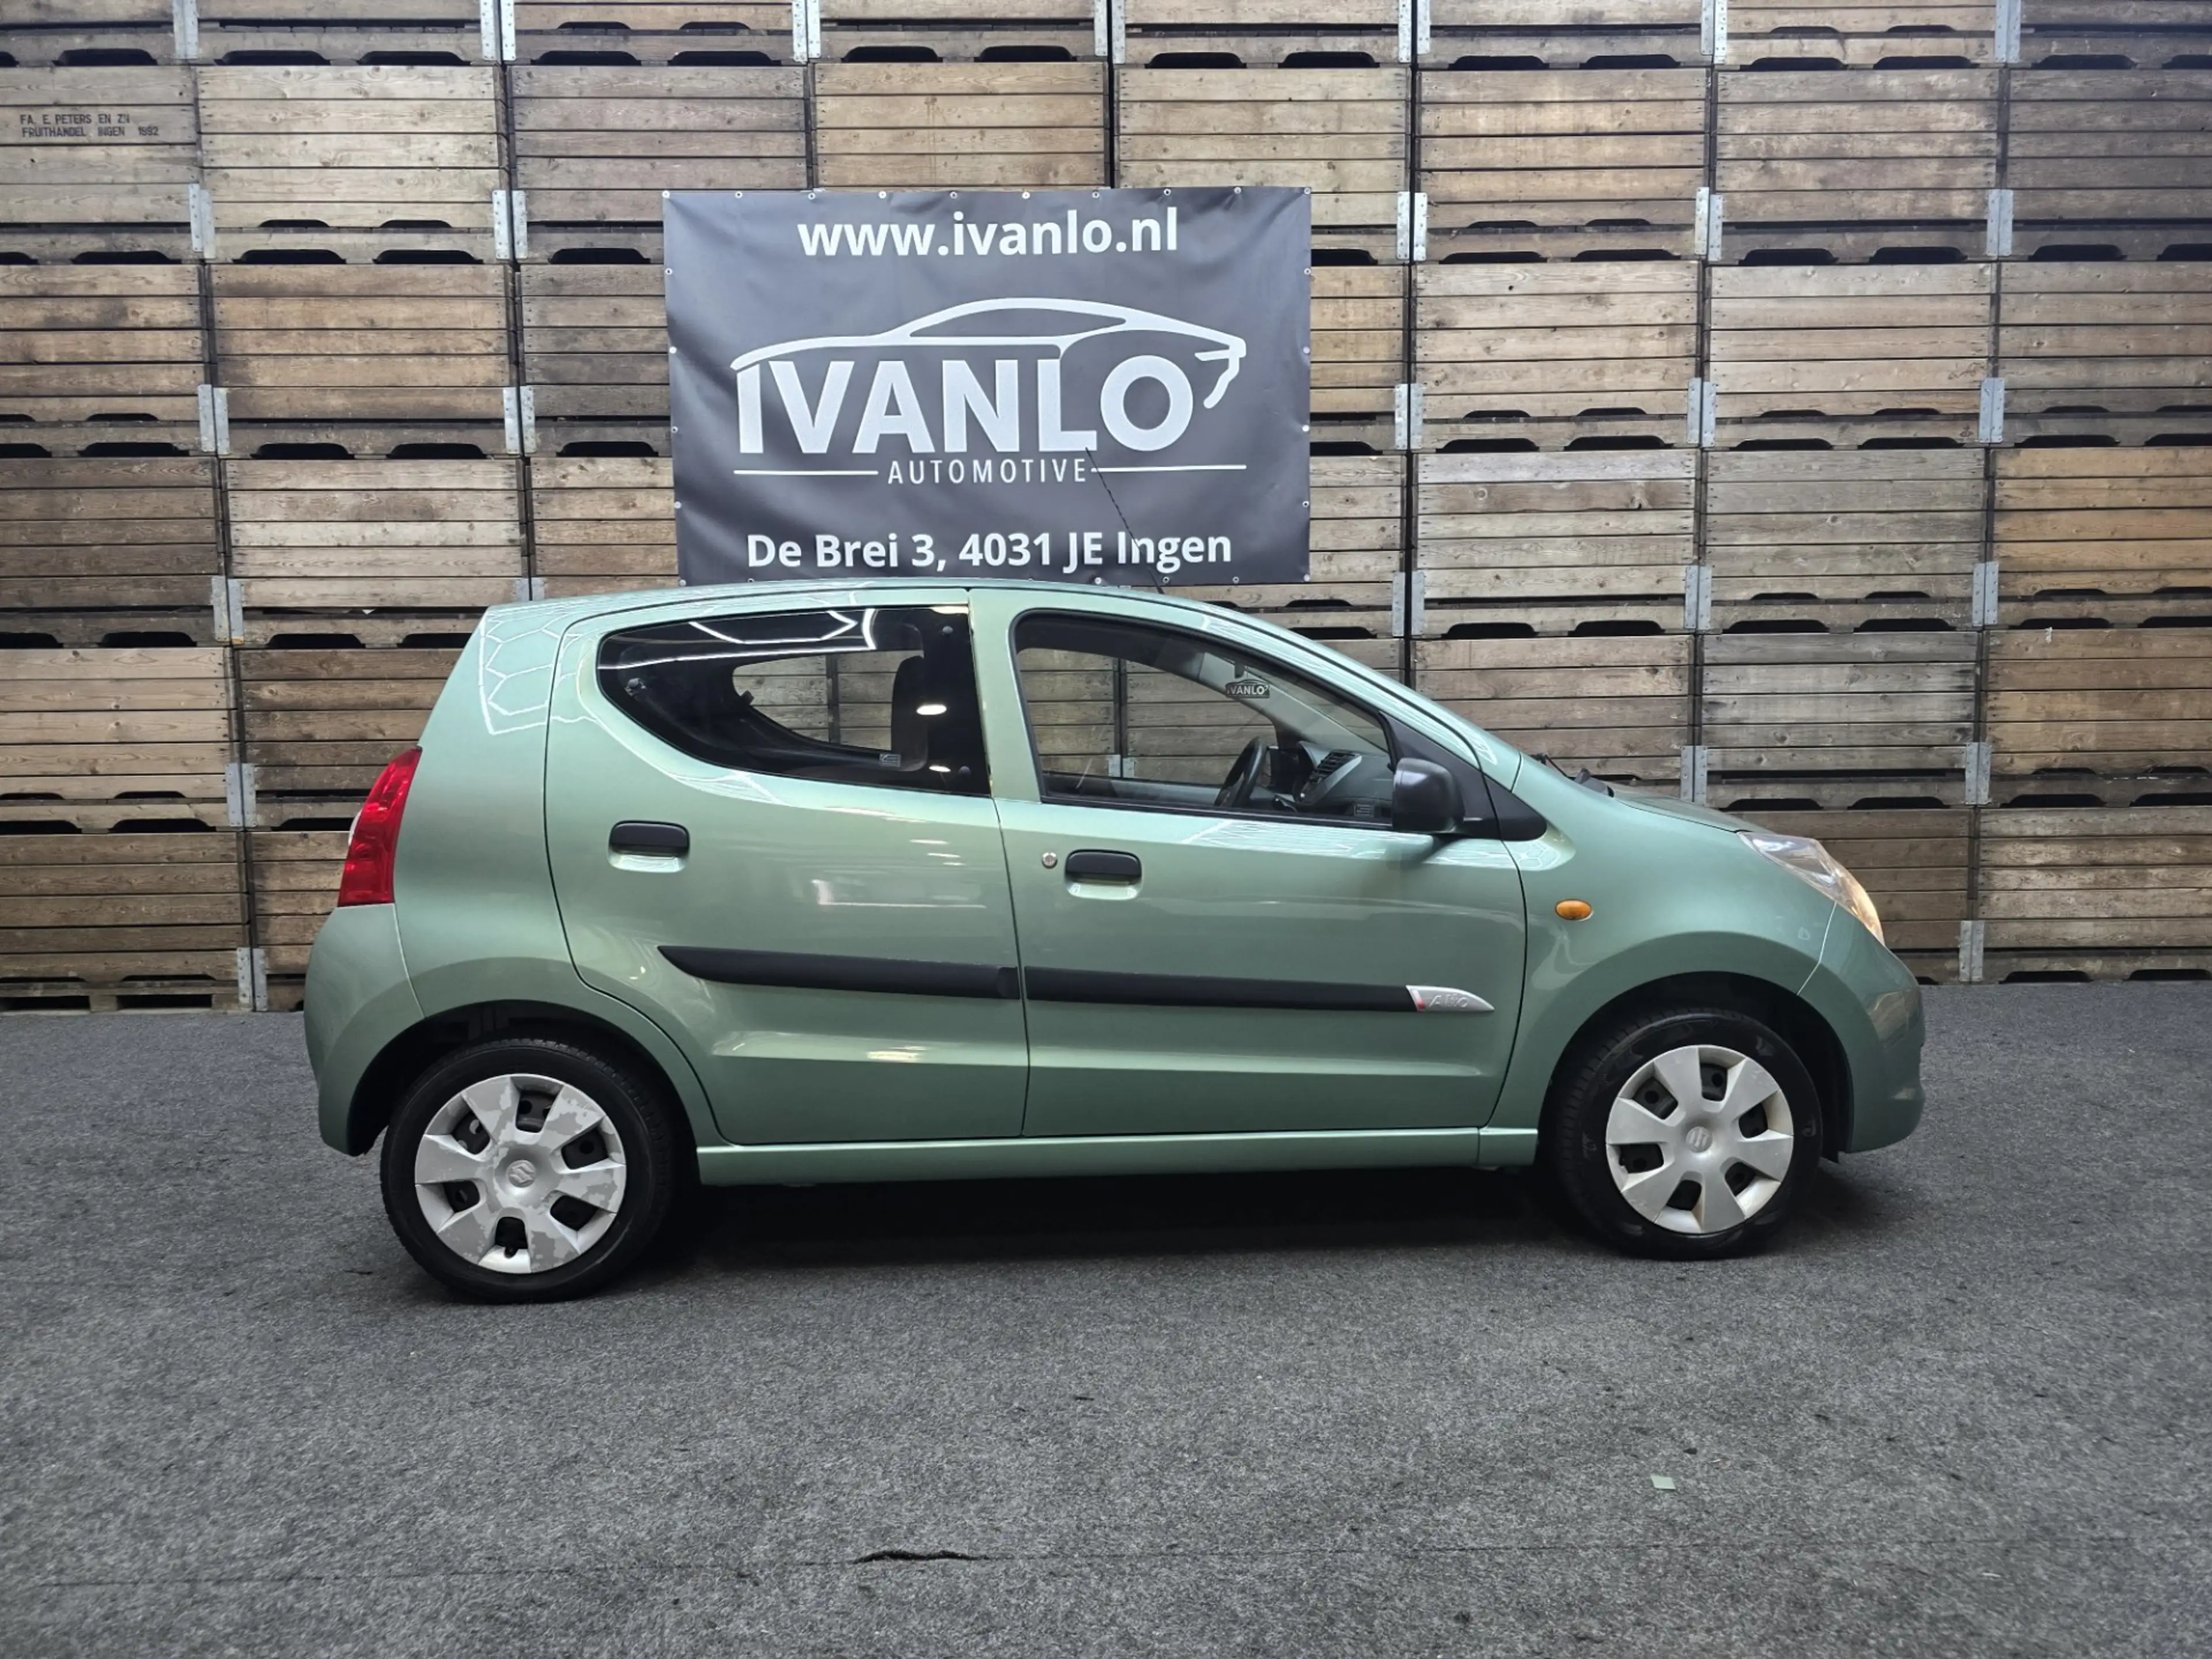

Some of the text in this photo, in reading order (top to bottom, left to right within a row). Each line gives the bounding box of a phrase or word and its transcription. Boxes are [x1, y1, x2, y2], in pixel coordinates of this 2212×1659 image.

[55, 114, 92, 124] PETERS
[97, 113, 111, 124] EN
[22, 126, 87, 138] FRUITHANDEL
[97, 126, 125, 137] INGEN
[797, 207, 1177, 256] www.ivanlo.nl
[737, 355, 1193, 453] IVANLO
[887, 459, 1086, 484] AUTOMOTIVE
[748, 532, 1232, 574] De Brei 3, 4031 JE Ingen
[1227, 685, 1265, 695] IVANLO
